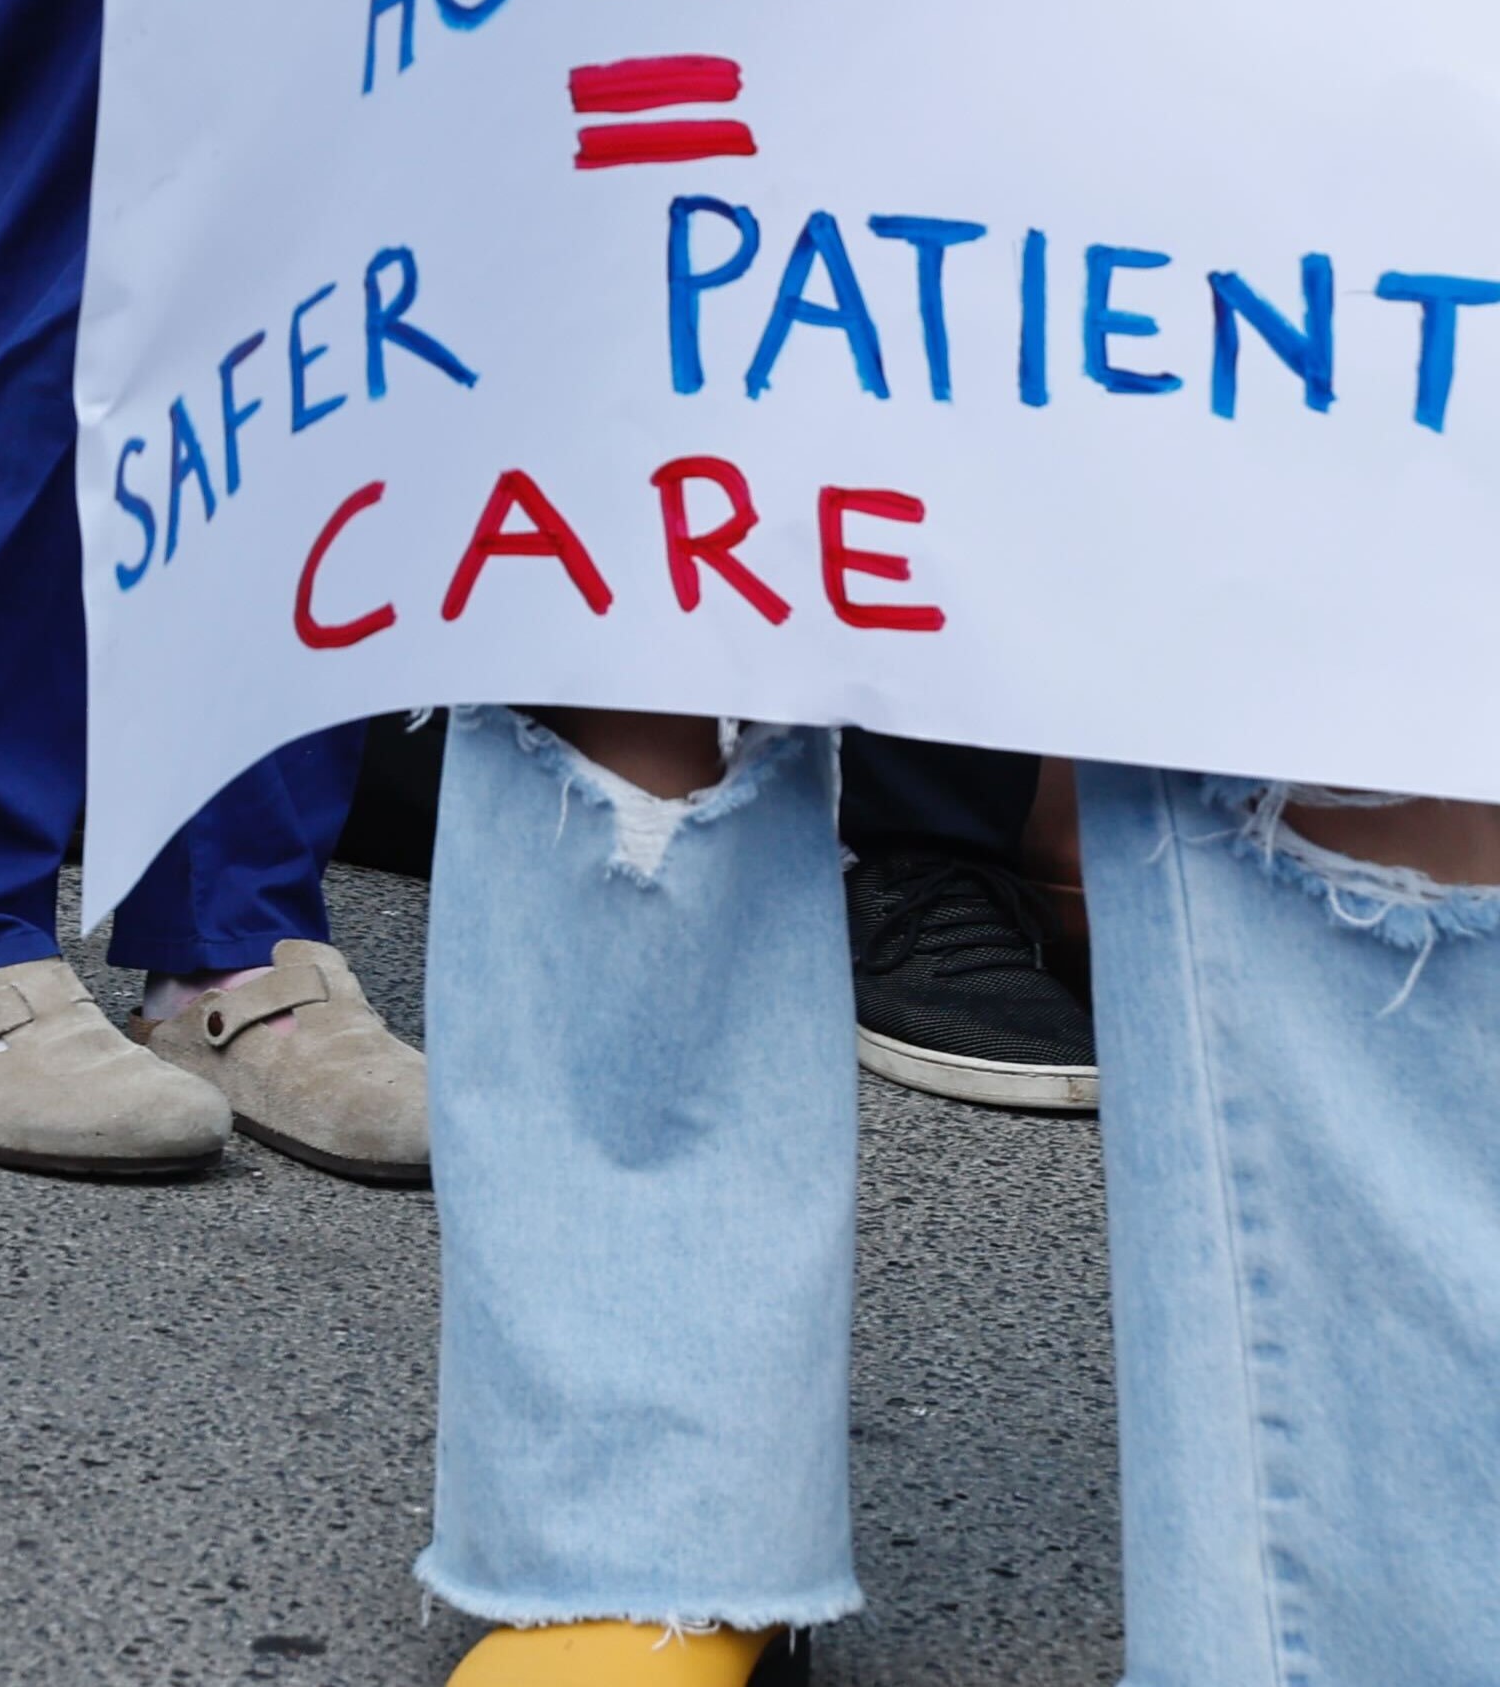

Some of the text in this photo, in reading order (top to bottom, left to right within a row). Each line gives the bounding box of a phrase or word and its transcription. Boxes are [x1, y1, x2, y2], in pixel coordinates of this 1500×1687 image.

[113, 195, 1500, 591] SAFER PATIENT
[293, 456, 945, 648] CARE
